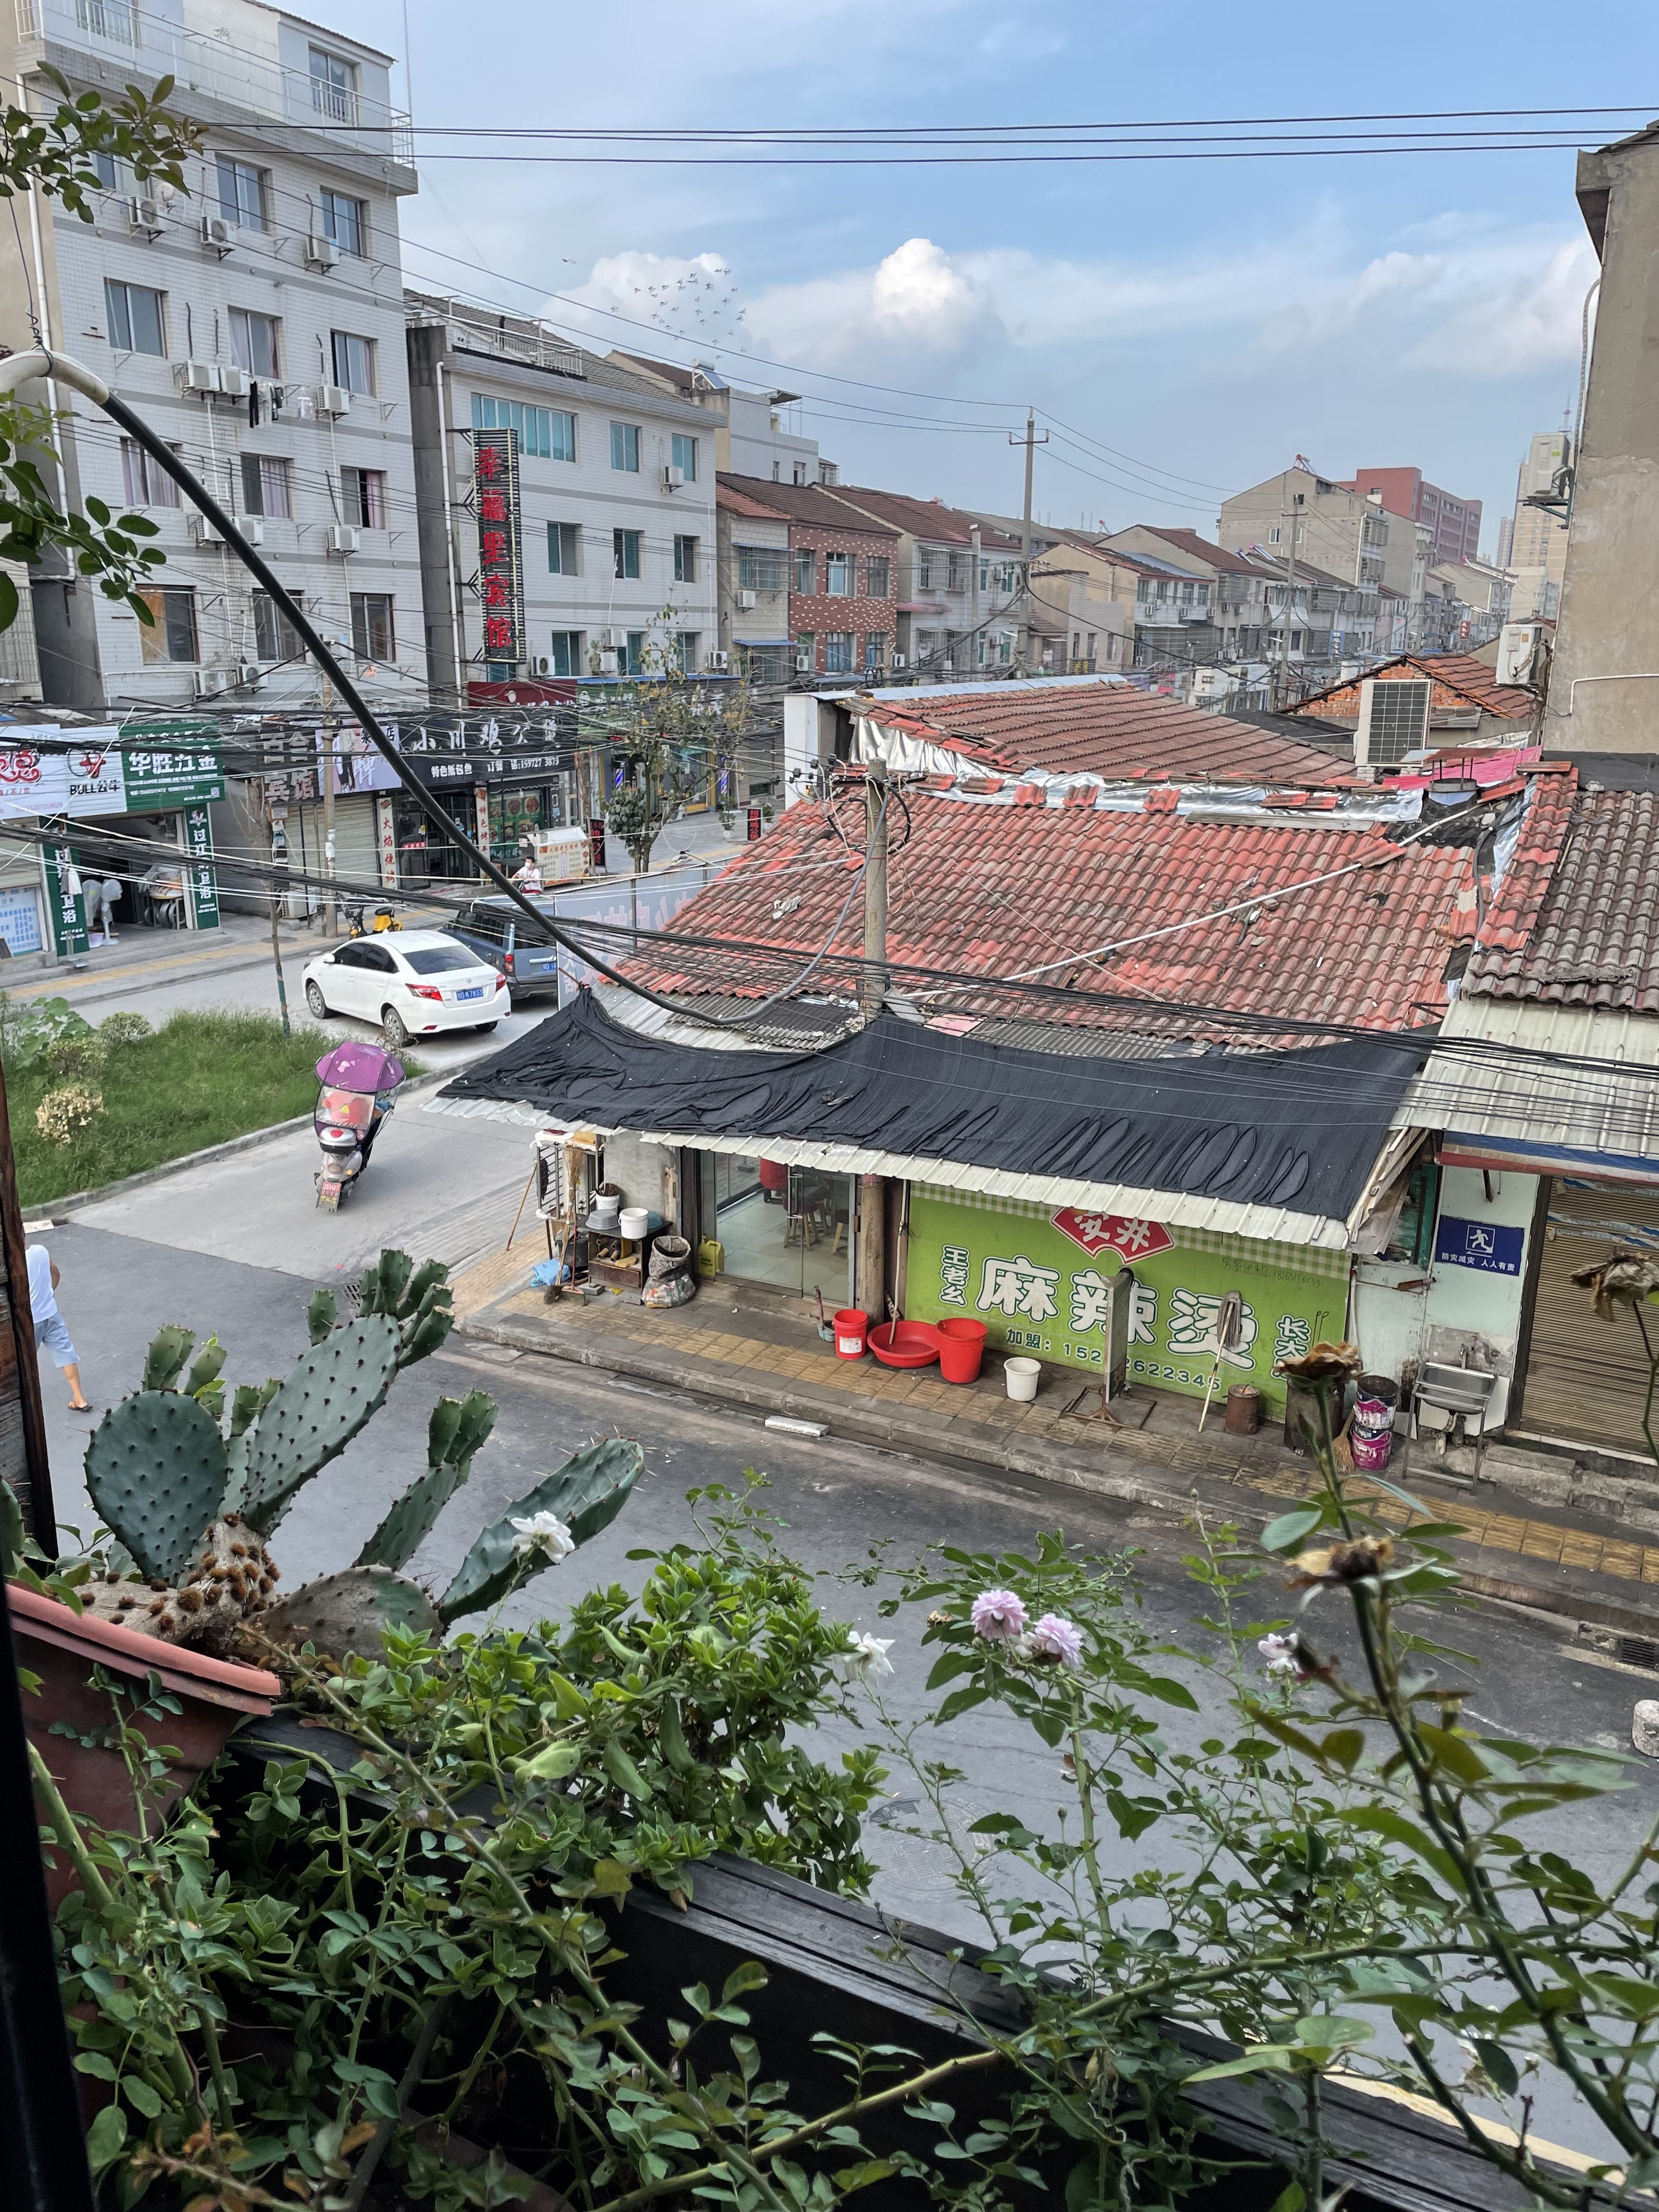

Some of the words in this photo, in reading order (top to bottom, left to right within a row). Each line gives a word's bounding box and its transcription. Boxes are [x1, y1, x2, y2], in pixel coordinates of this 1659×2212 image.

[477, 445, 512, 647] 幸福里宾馆
[360, 725, 394, 744] 集店
[264, 770, 314, 803] 宾馆
[1074, 1211, 1150, 1252] 安井
[1221, 1257, 1267, 1277] 房屋出租
[1442, 1252, 1475, 1265] 防灾减灾
[1481, 1259, 1515, 1272] 人人有责
[975, 1255, 1259, 1370] 麻辣烫
[1063, 1342, 1221, 1391] 152622345
[1270, 1314, 1311, 1380] 长大
